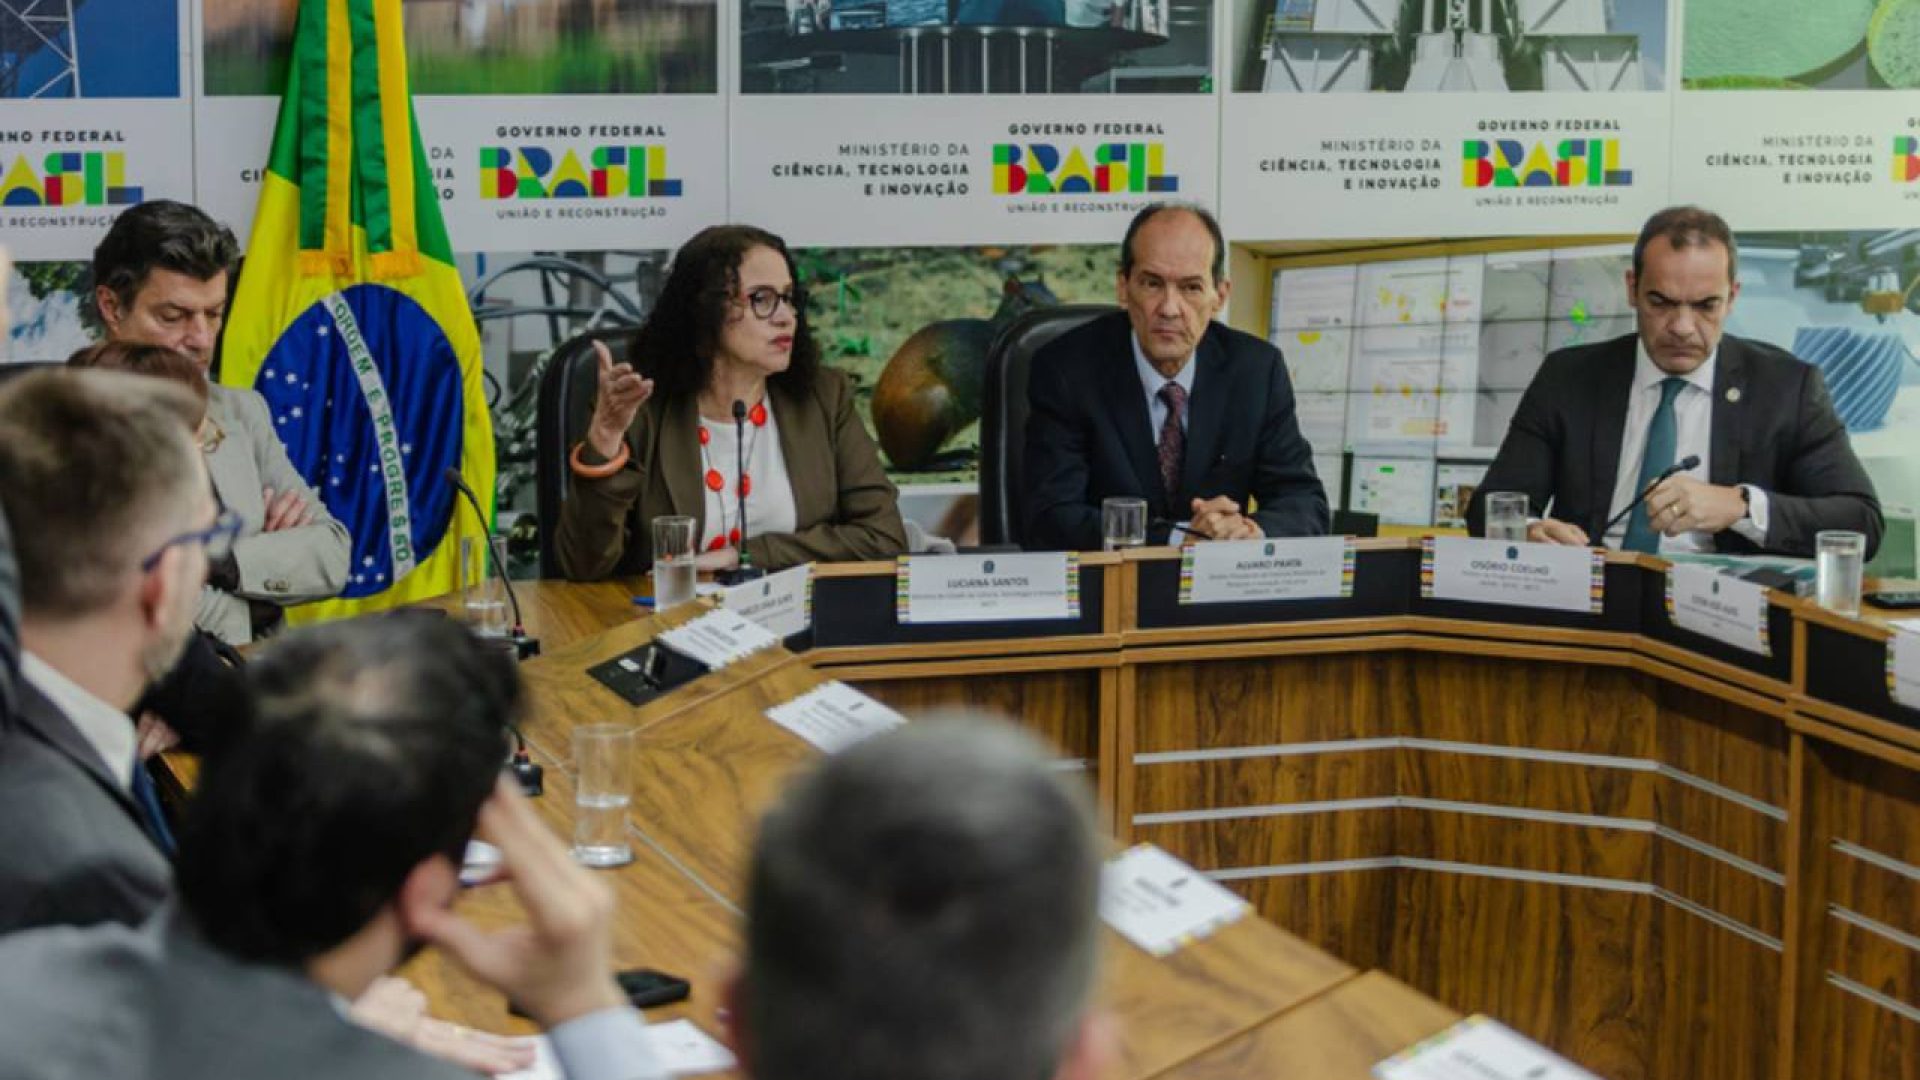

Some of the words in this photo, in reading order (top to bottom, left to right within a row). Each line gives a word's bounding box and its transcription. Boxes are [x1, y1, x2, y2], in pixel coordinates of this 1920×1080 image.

[496, 126, 582, 138] GOVERNO
[589, 125, 665, 137] FEDERAL
[1008, 123, 1086, 135] GOVERNO
[1094, 123, 1164, 135] FEDERAL
[1477, 120, 1548, 131] GOVERNO
[1555, 120, 1620, 131] FEDERAL
[42, 130, 124, 142] FEDERAL
[1762, 135, 1848, 148] MINISTÉRIO
[1854, 135, 1874, 147] DA
[838, 142, 940, 156] MINISTÉRIO
[948, 143, 969, 156] DA
[1321, 138, 1414, 152] MINISTÉRIO
[1421, 139, 1440, 151] DA
[432, 147, 454, 159] DA
[1706, 153, 1771, 166] CIÊNCIA,
[1779, 154, 1872, 166] TECNOLOGIA
[772, 162, 849, 177] CIÊNCIA,
[858, 163, 969, 176] TECNOLOGIA
[992, 143, 1179, 194] BRASIL
[1260, 158, 1331, 172] CIÊNCIA,
[1338, 159, 1440, 171] TECNOLOGIA
[1461, 138, 1633, 188] BRASIL
[0, 152, 144, 206] ASIL
[480, 145, 682, 199] BRASIL
[1783, 172, 1791, 184] E
[1797, 170, 1872, 185] INOVAÇÃO
[864, 184, 873, 196] E
[880, 181, 969, 197] INOVAÇÃO
[1344, 178, 1352, 189] E
[1359, 175, 1440, 190] INOVAÇÃO
[496, 207, 540, 220] UNIÃO
[558, 206, 666, 219] RECONSTRUÇÃO
[1007, 202, 1048, 213] UNIÃO
